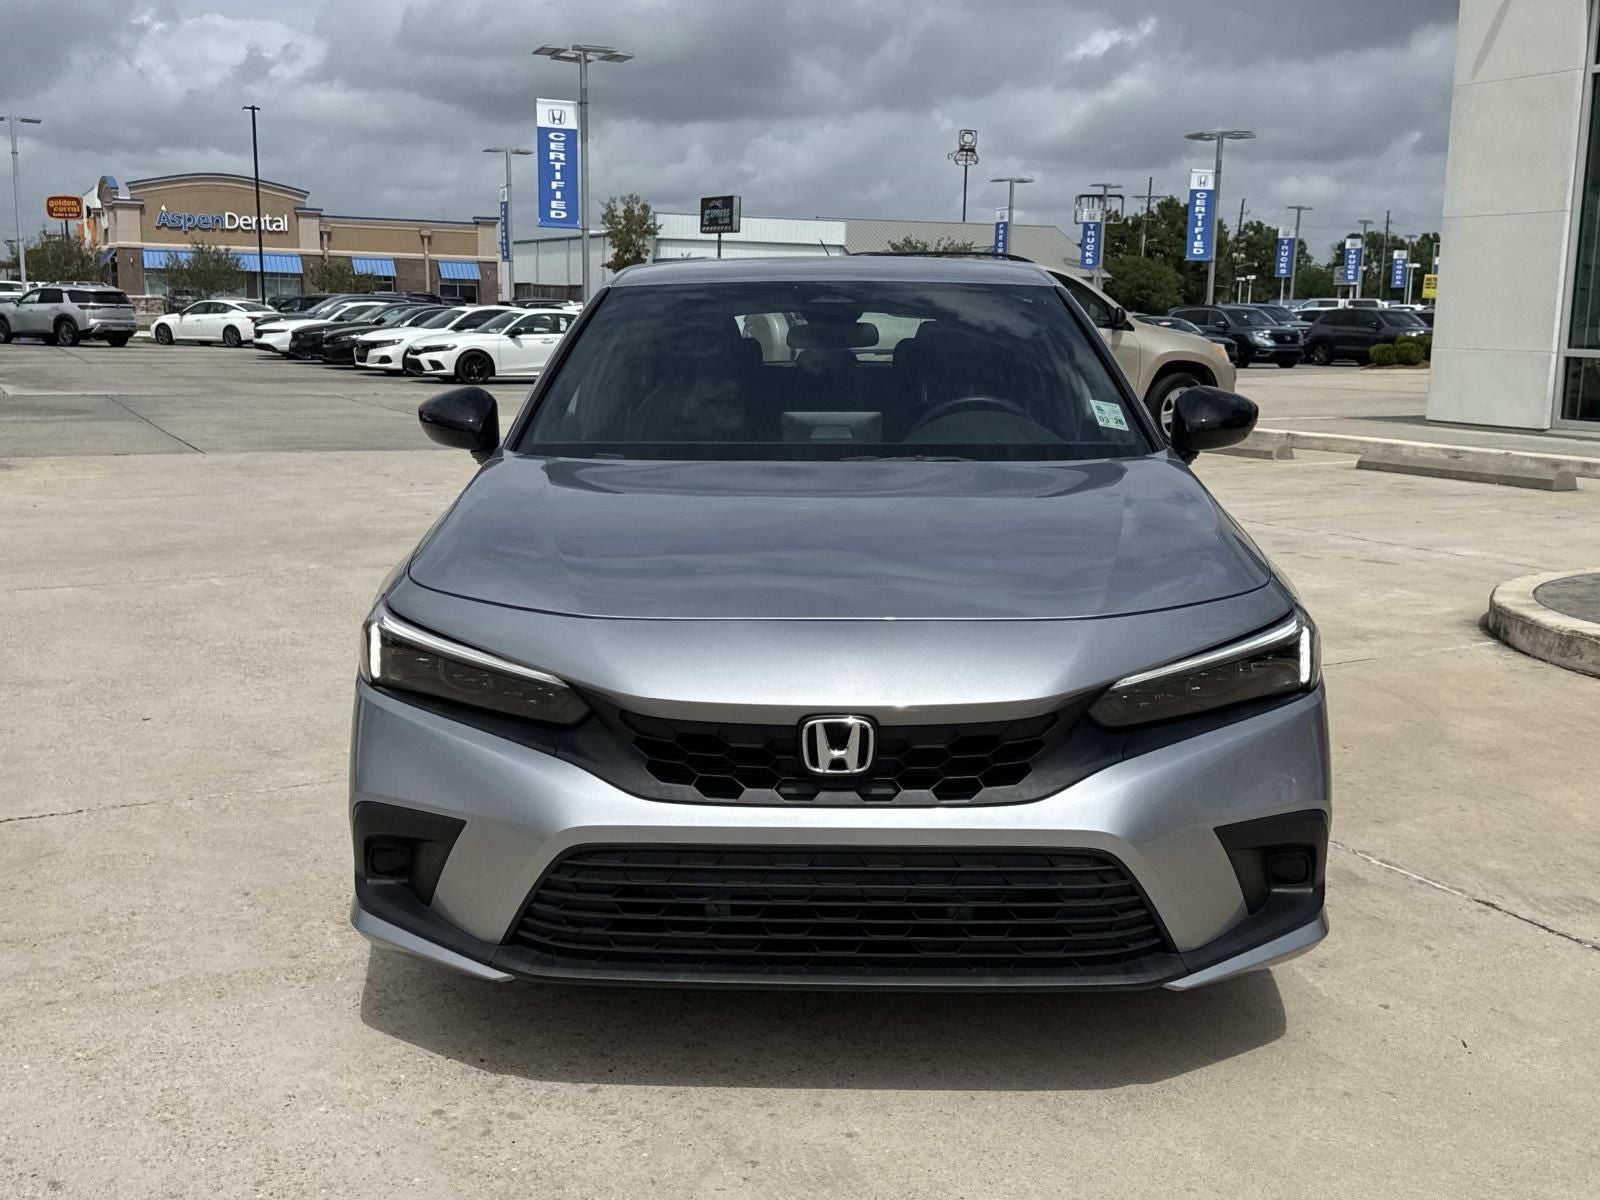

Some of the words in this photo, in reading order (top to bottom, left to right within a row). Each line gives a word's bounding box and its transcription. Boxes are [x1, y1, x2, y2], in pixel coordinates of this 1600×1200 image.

[548, 132, 568, 219] CERTIFIED
[48, 199, 77, 208] golden
[1193, 192, 1208, 255] CERTIFIED
[1085, 224, 1096, 265] TRUCKS
[1278, 239, 1288, 274] TRUCKS
[1347, 249, 1357, 280] TRUCKS
[1394, 259, 1403, 285] HONDA
